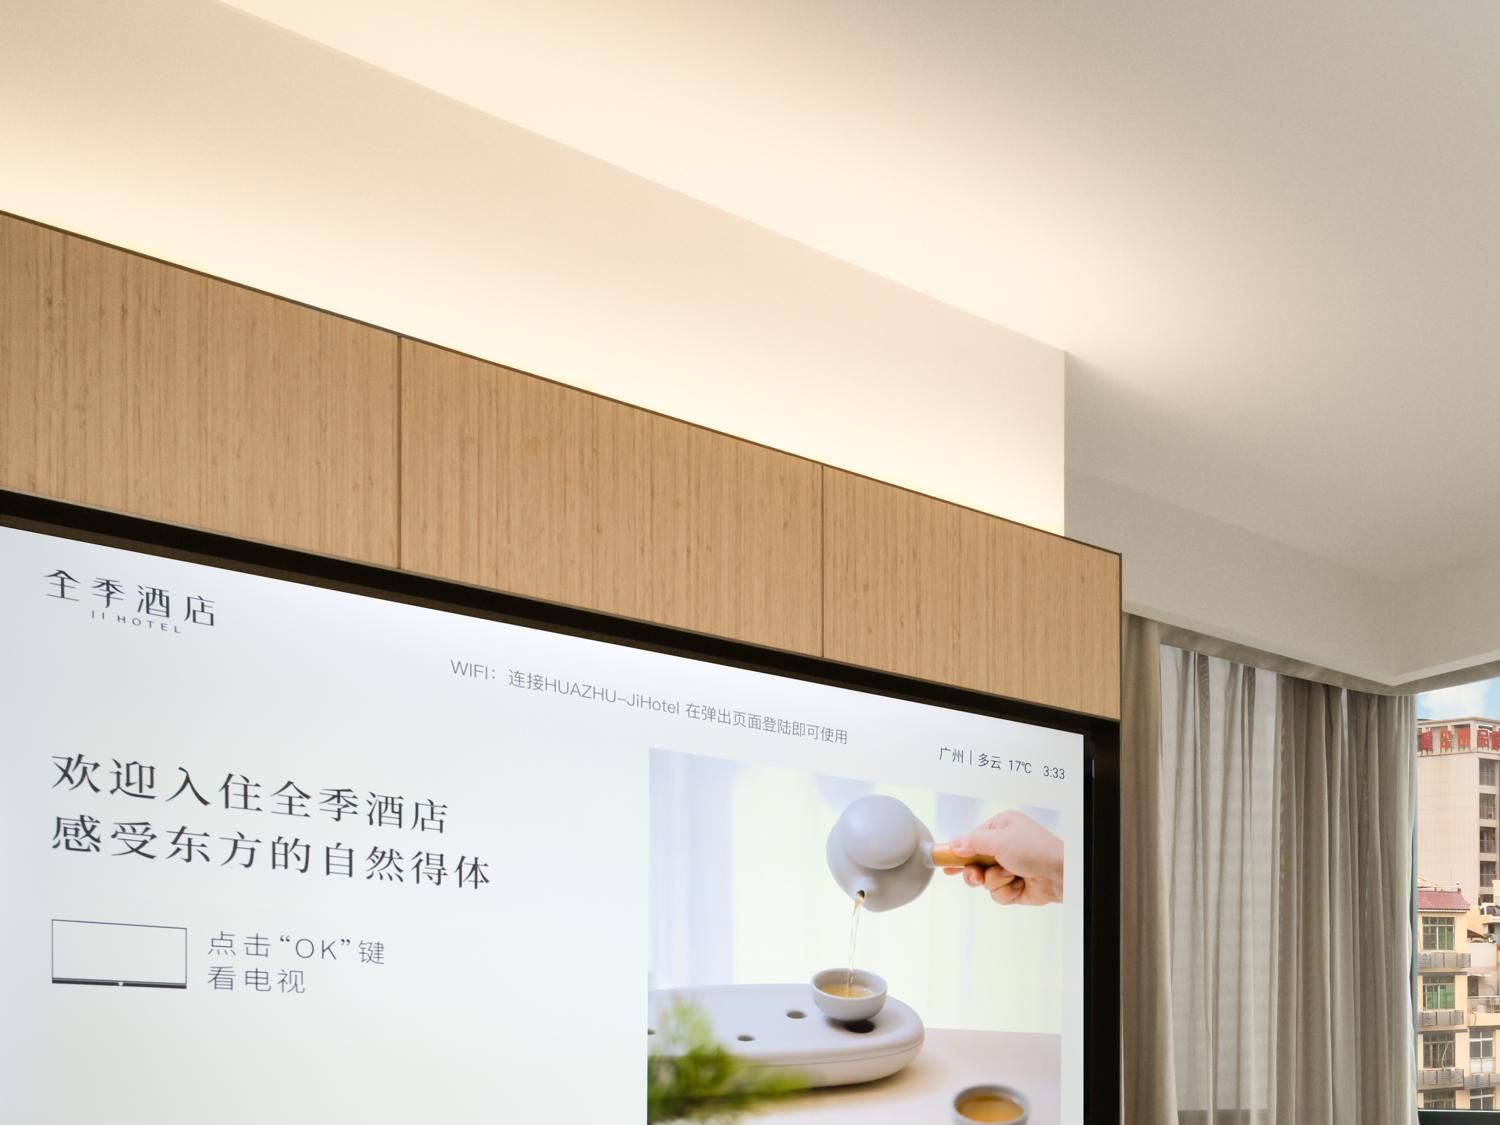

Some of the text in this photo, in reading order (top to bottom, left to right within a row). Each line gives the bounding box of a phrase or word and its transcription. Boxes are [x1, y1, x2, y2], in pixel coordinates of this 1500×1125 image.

[44, 569, 215, 627] 全季酒店
[117, 615, 182, 634] HOTEL
[685, 702, 849, 746] 在弹出页面登陆即可使用
[939, 746, 964, 764] 广州
[978, 752, 1002, 770] 多云
[1043, 765, 1066, 780] 3:33
[51, 753, 449, 835] 欢迎入住全季酒店
[51, 814, 491, 891] 感受东方的自然得体
[207, 966, 307, 995] 看电视
